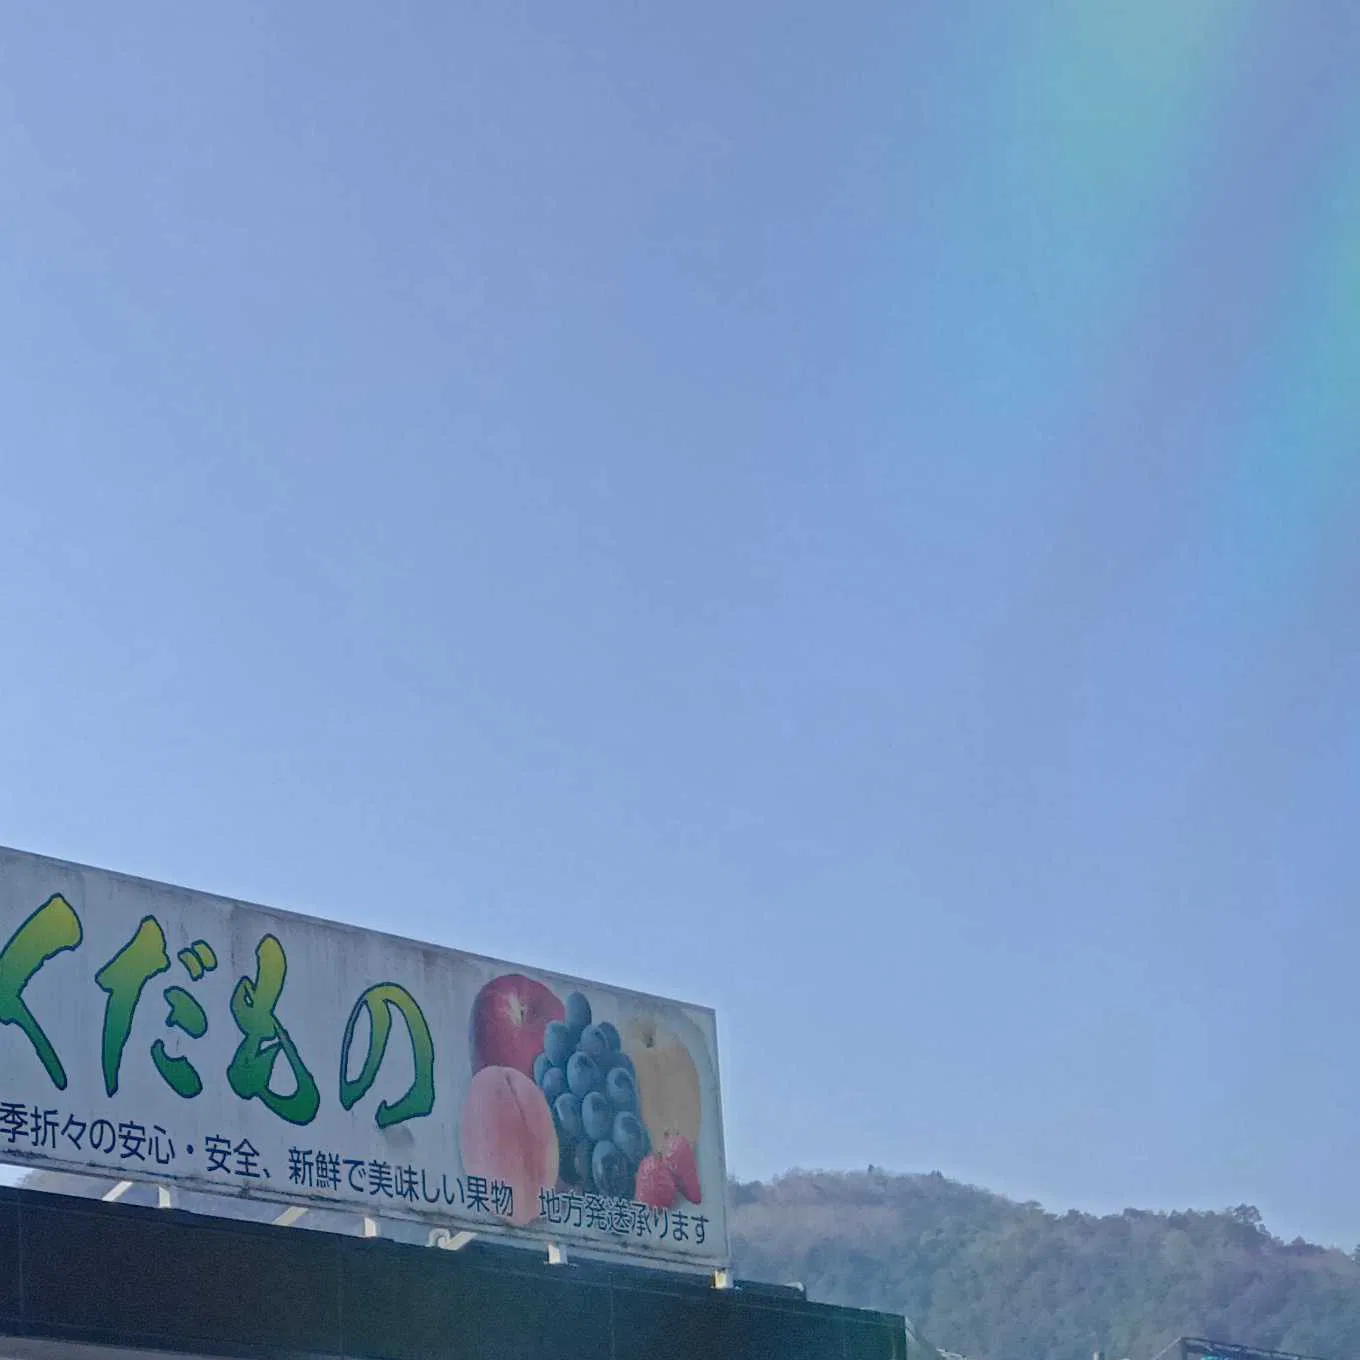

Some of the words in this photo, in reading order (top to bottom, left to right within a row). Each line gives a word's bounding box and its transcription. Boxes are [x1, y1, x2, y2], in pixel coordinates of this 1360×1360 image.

[538, 1187, 711, 1246] 地方発送承ります
